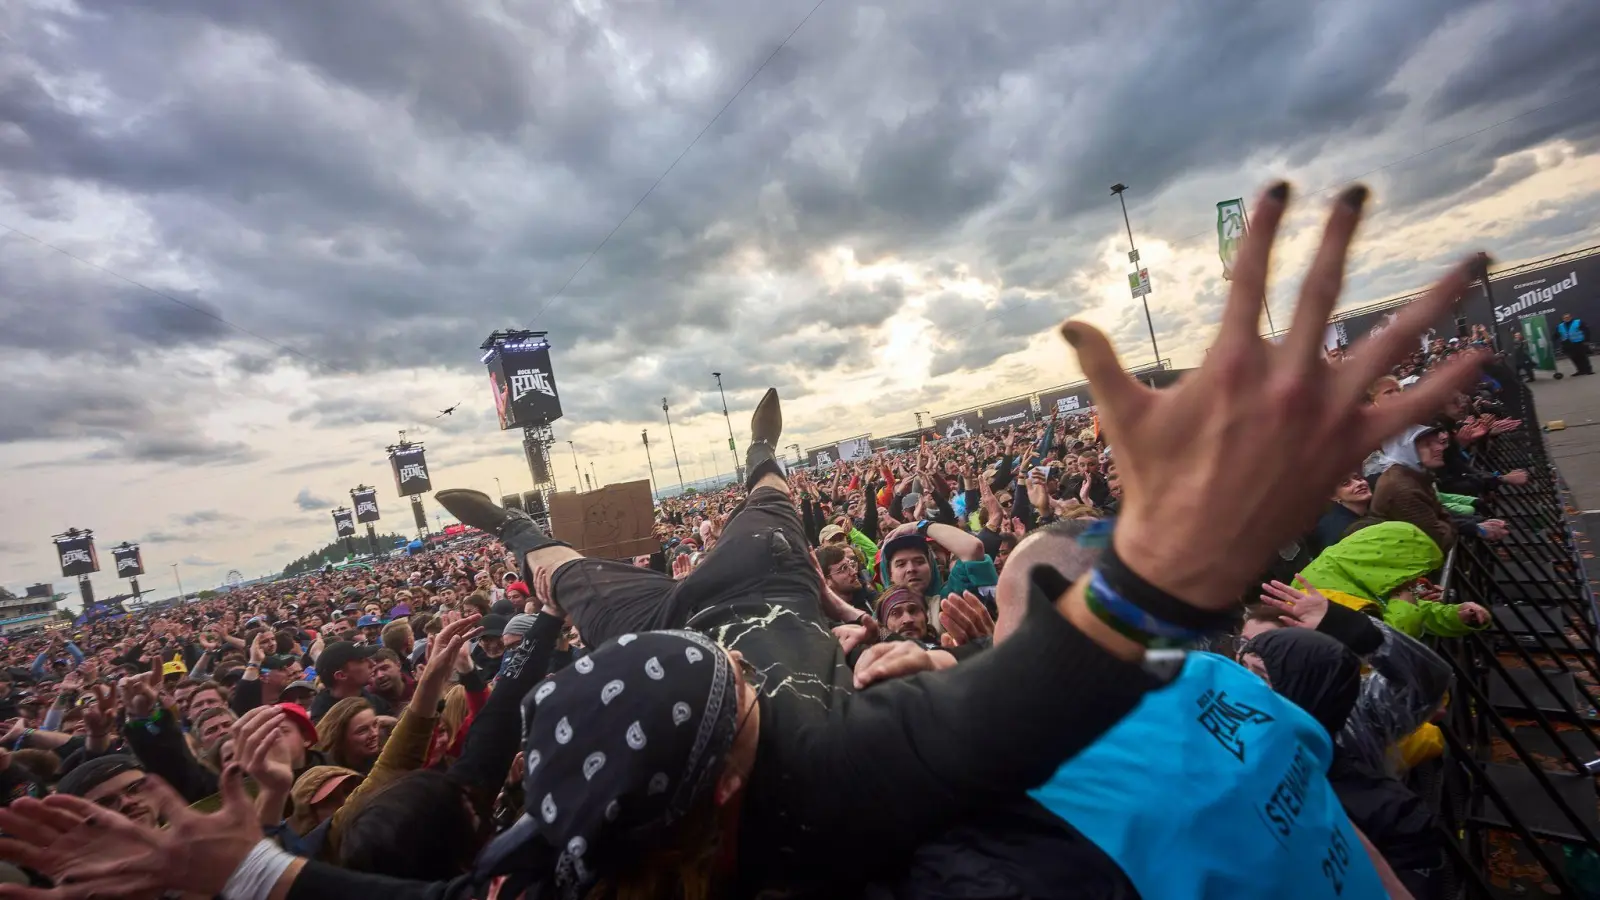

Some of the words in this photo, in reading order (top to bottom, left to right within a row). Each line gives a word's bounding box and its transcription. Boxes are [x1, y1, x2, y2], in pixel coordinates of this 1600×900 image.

[509, 373, 556, 402] RING
[399, 465, 428, 484] RING
[62, 550, 92, 568] RING
[1197, 690, 1275, 764] RING
